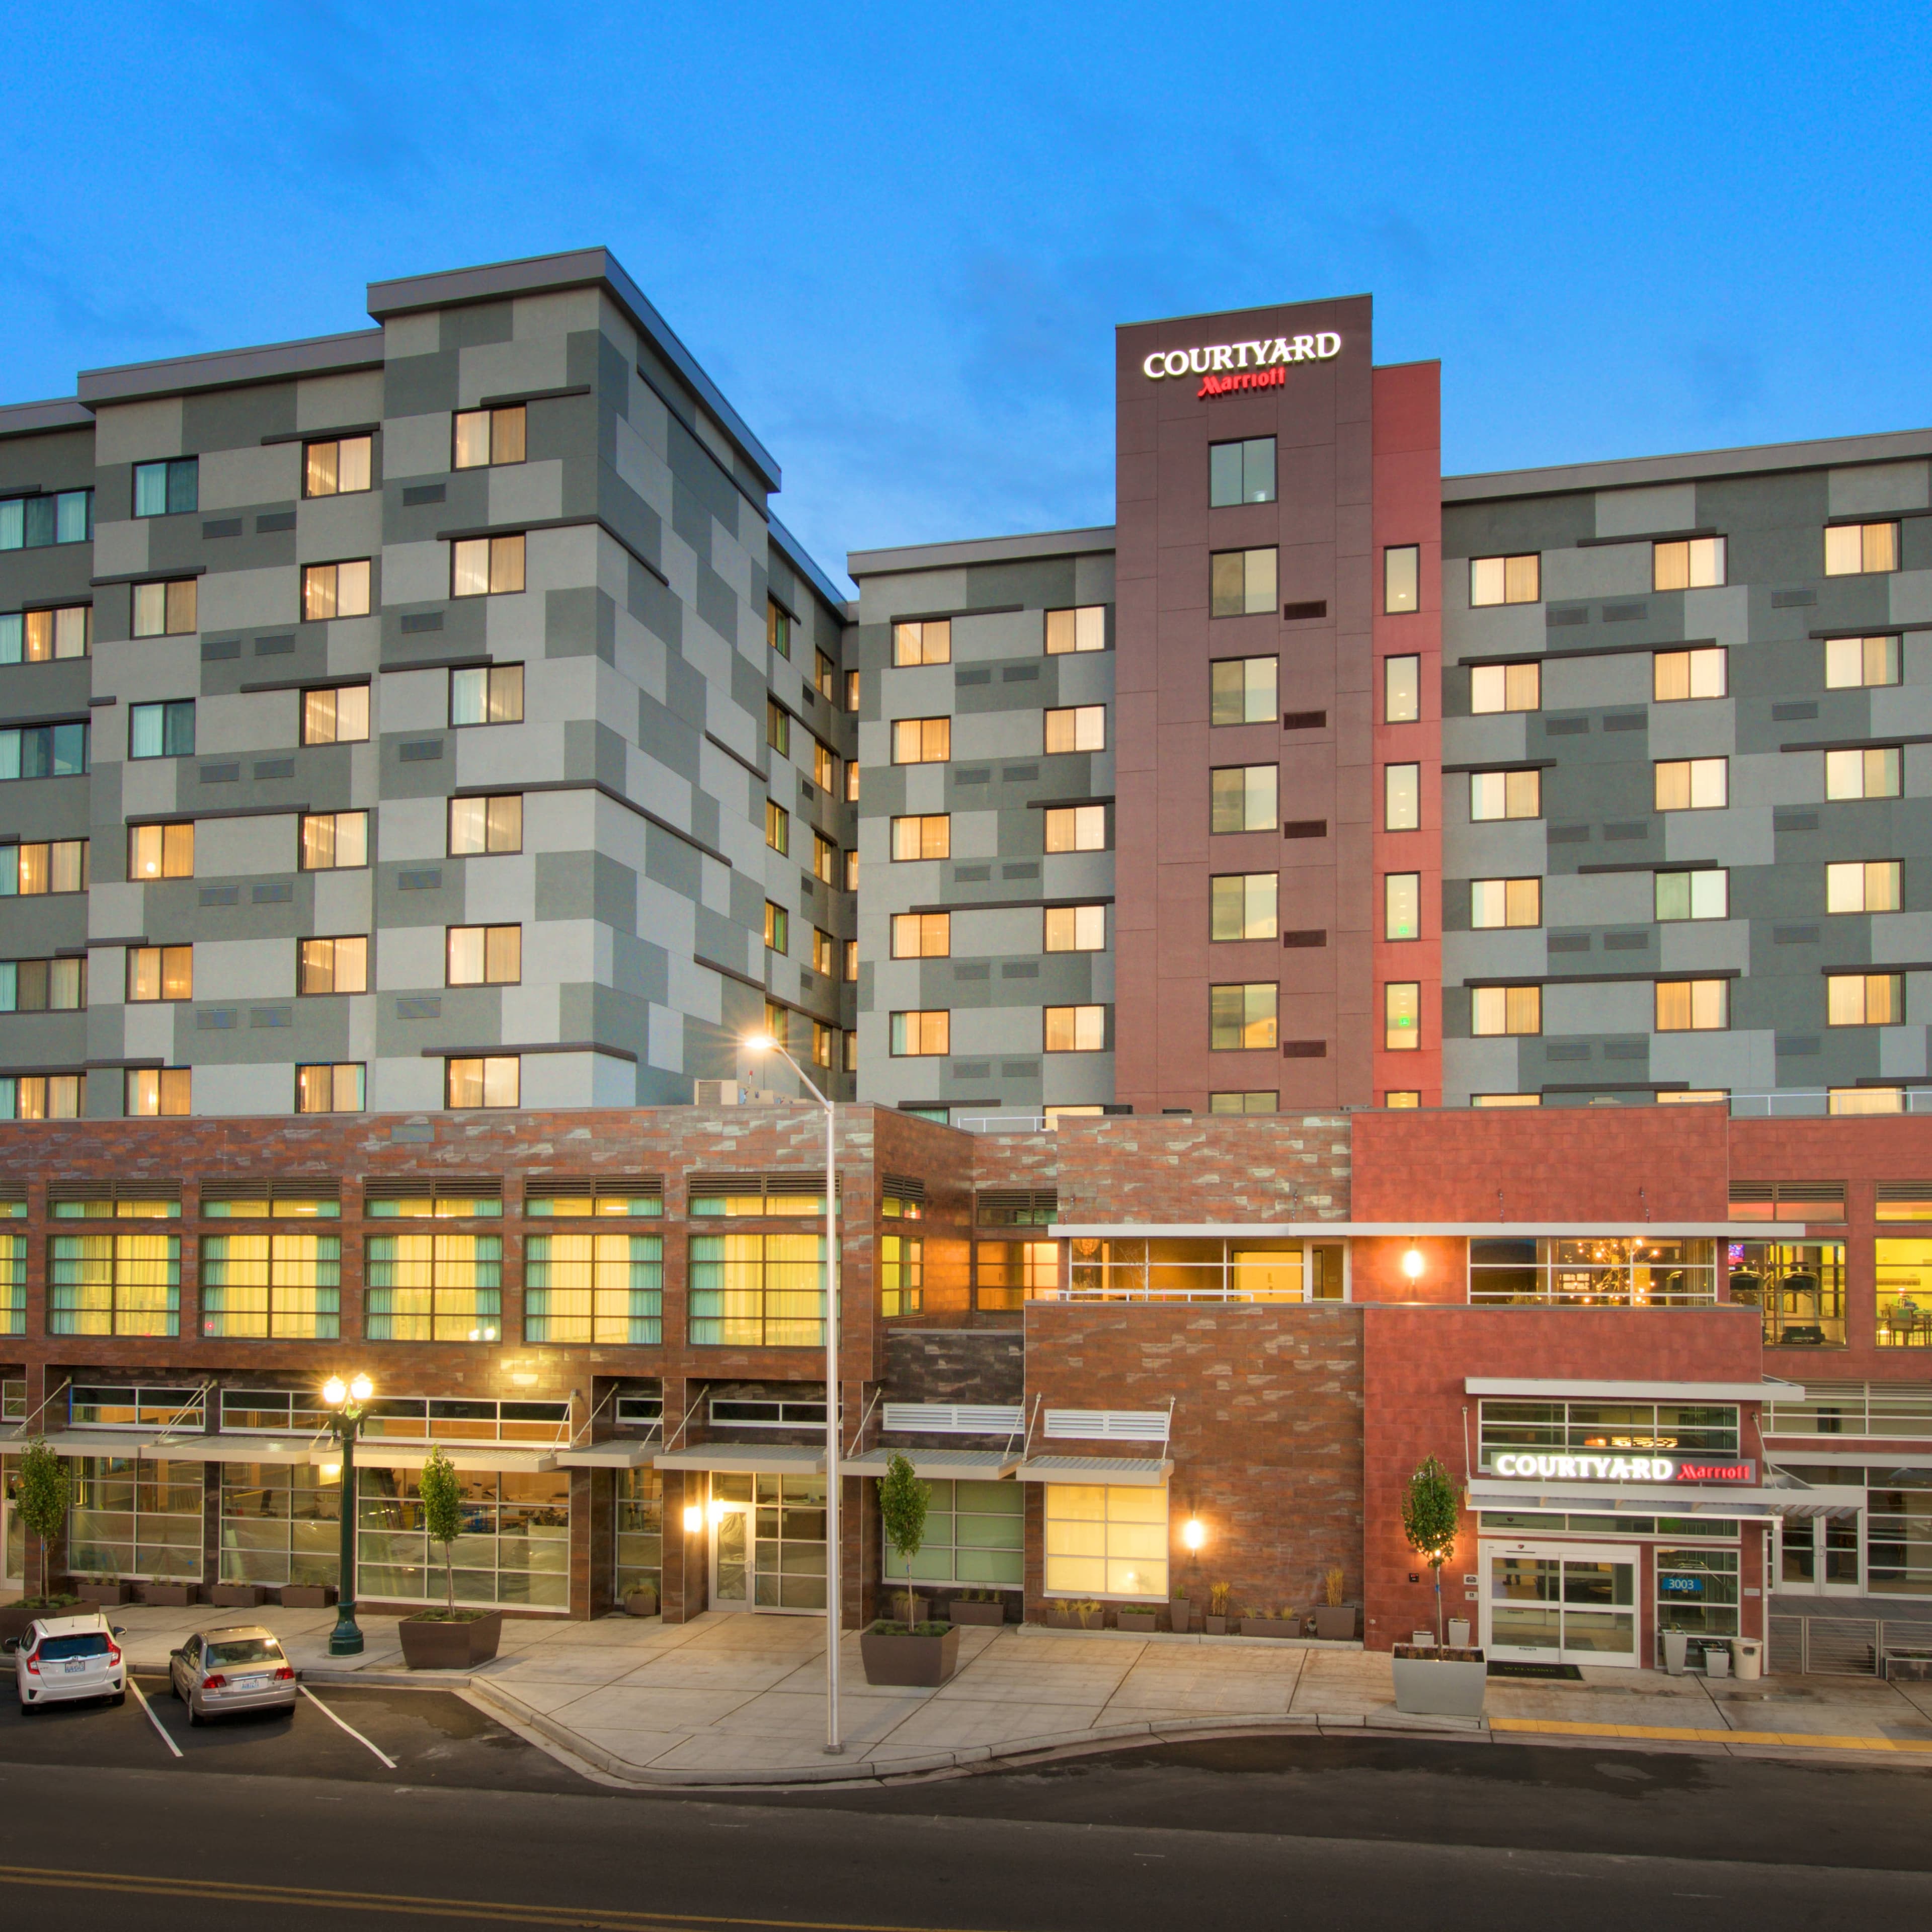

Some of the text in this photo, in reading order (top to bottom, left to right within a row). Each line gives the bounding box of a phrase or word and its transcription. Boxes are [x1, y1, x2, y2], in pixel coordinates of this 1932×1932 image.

[1144, 332, 1341, 378] COURTYARD
[1197, 366, 1285, 397] Marriott
[1496, 1455, 1750, 1480] COURTYARD Marriott
[1668, 1579, 1694, 1589] 3003
